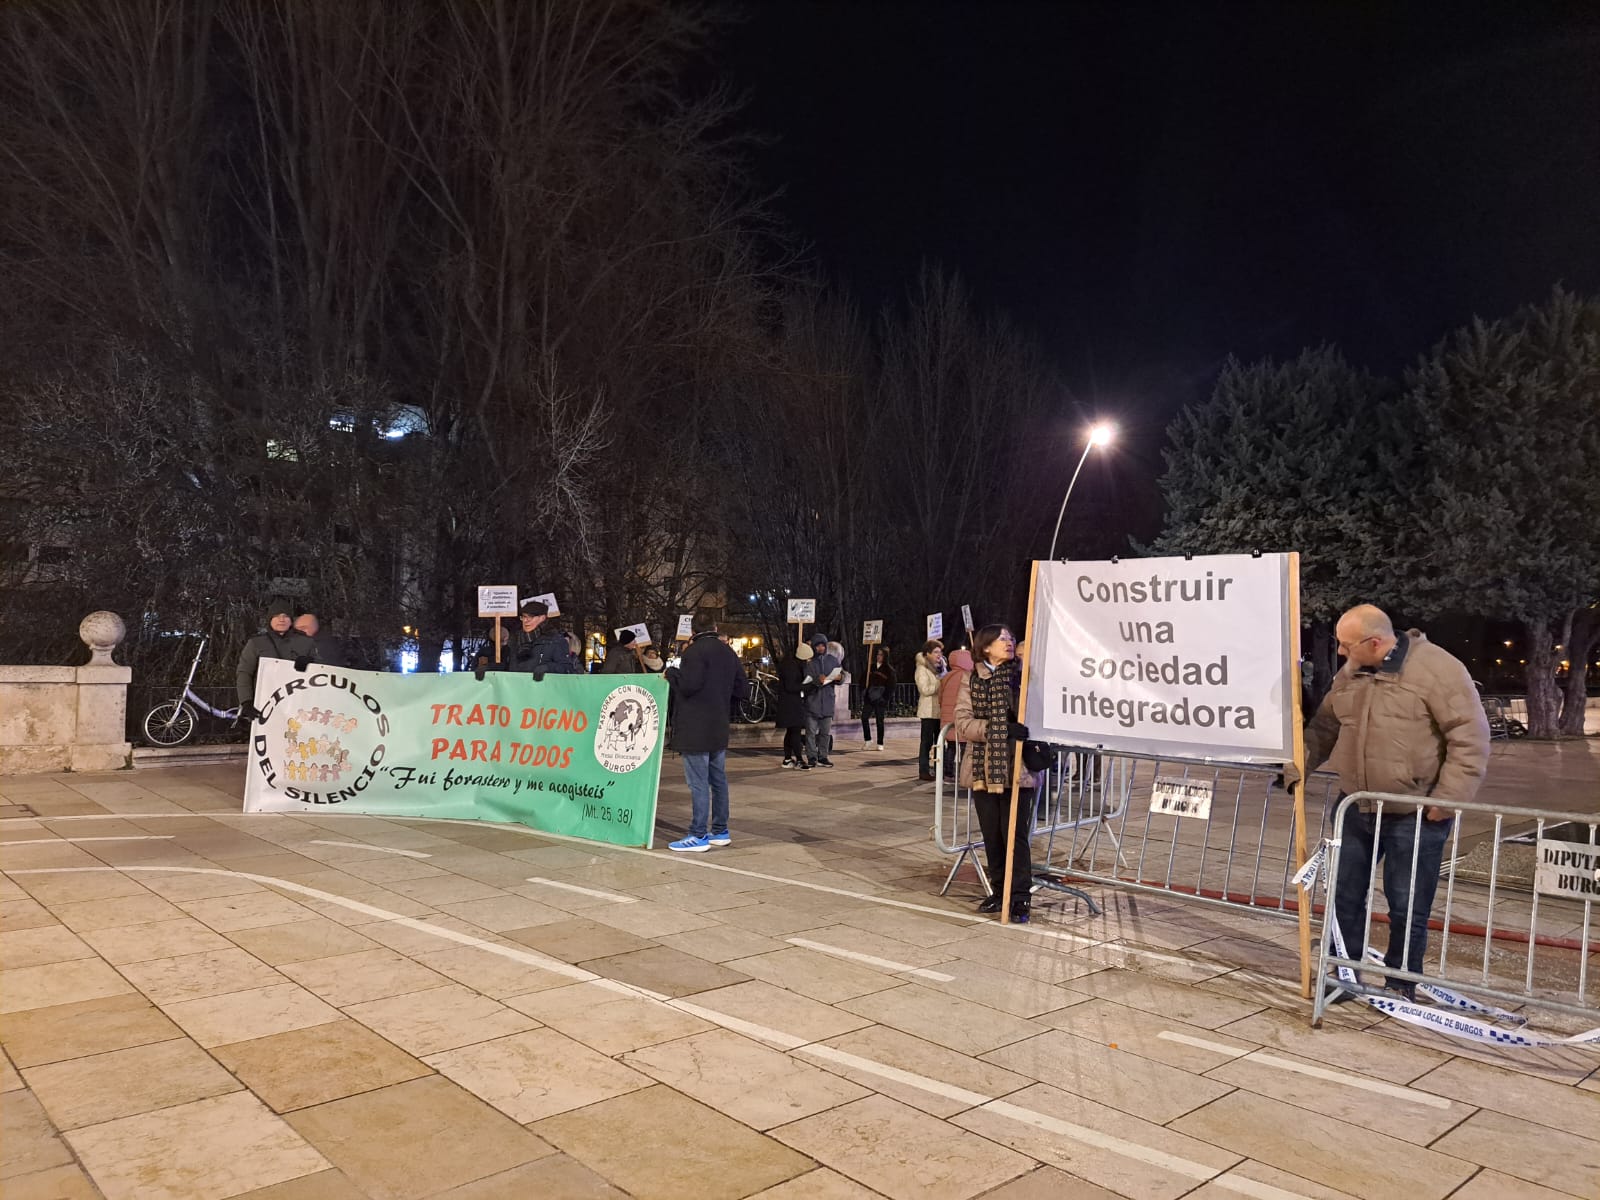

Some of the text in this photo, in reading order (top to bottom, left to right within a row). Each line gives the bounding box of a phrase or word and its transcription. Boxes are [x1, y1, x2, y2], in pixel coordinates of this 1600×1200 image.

[1077, 571, 1233, 603] Construir
[1118, 619, 1175, 643] una
[1080, 654, 1229, 685] sociedad
[258, 673, 390, 737] CIRCULOS
[431, 703, 588, 733] TRATO DIGNO
[598, 685, 659, 731] PASTORAL CON INMIGRANTES
[1061, 687, 1256, 729] integradora
[431, 738, 574, 769] PARA TODOS
[603, 760, 637, 773] BURGOS
[254, 734, 386, 805] DEL SILENCIO
[443, 768, 511, 792] forastero
[513, 780, 522, 794] y
[527, 780, 544, 792] me
[1399, 1005, 1484, 1037] POLICIA LOCAL DE BURGOS
